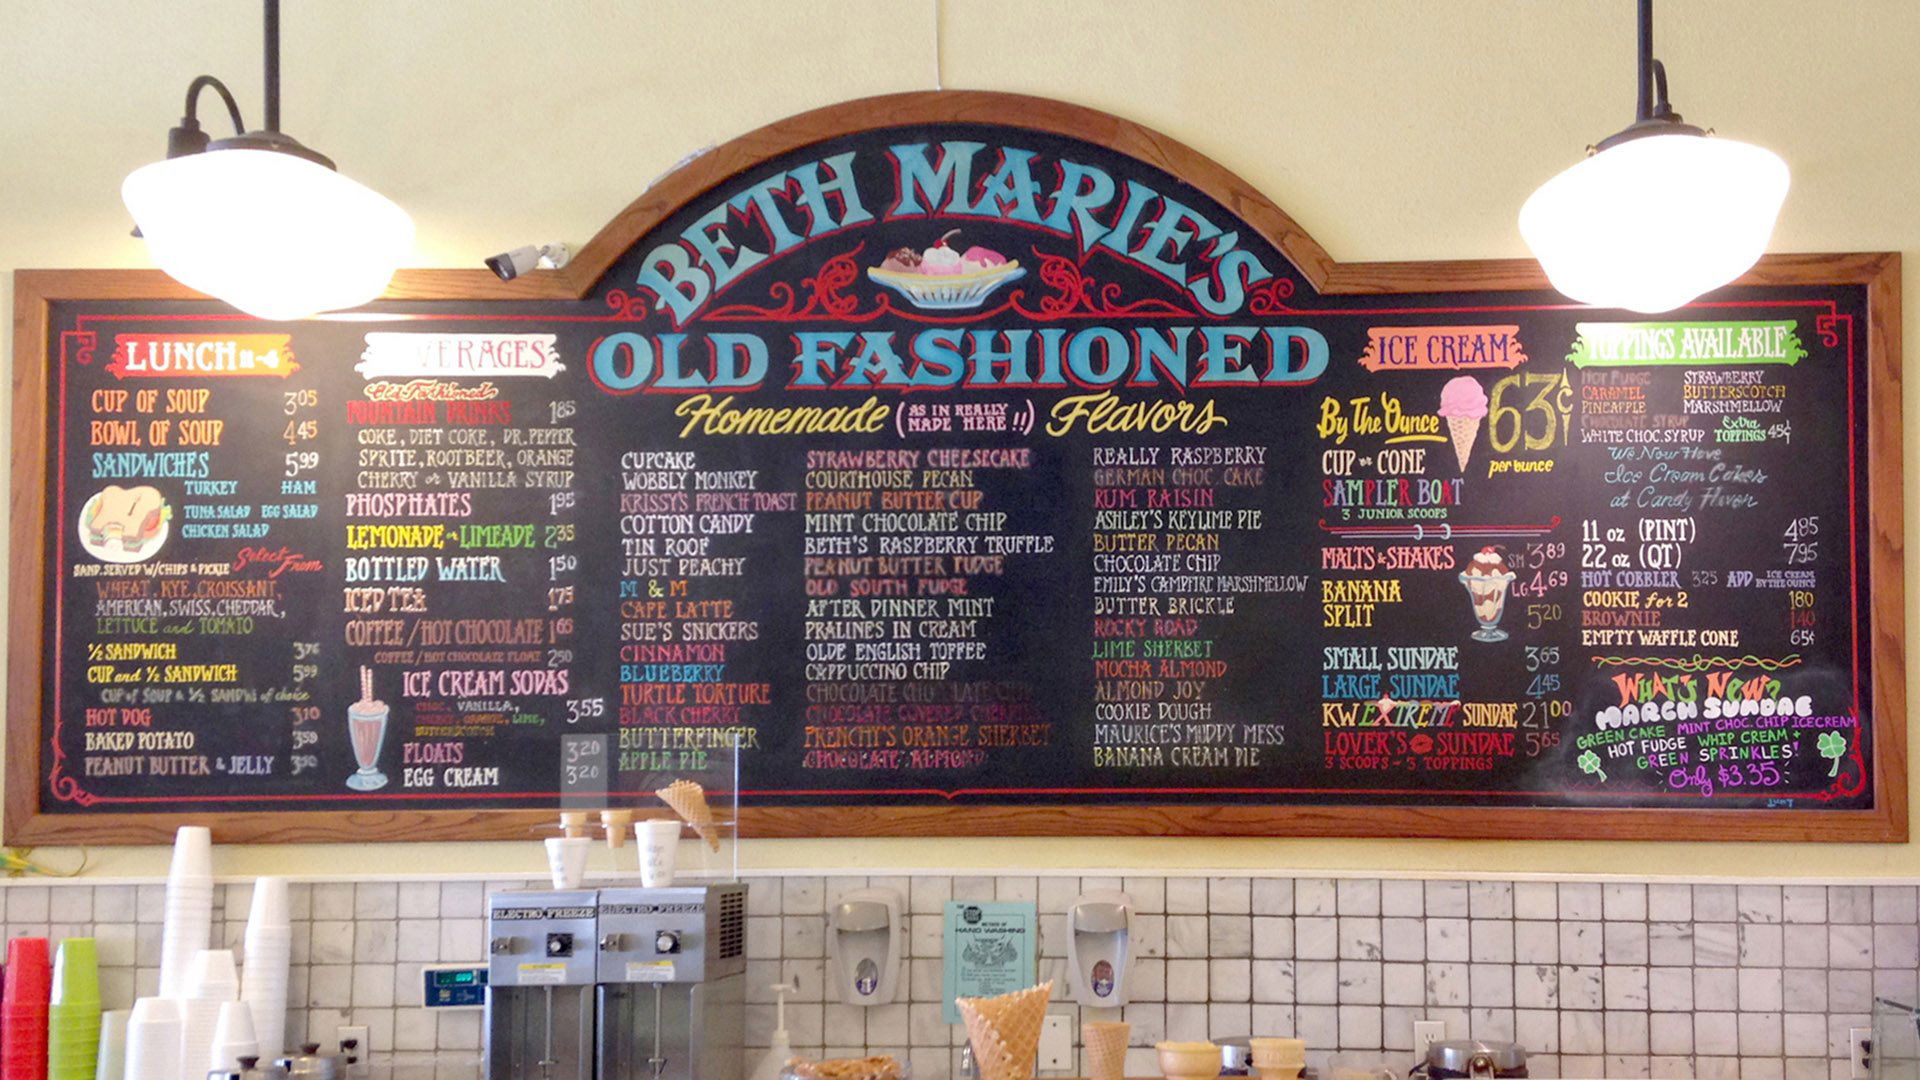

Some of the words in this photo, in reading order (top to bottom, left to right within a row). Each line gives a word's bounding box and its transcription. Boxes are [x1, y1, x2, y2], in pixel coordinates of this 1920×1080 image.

[636, 152, 876, 327] BETH
[884, 140, 1274, 318] MARIE'S
[1379, 335, 1417, 365] ICE
[1427, 333, 1509, 365] CREAM
[1586, 329, 1675, 360] TOPPINGS
[1680, 326, 1787, 359] AVAILABLE
[125, 342, 237, 370] LUNCH
[413, 339, 546, 370] VERAGES
[587, 330, 770, 396] OLD
[786, 325, 1332, 393] FASHIONED
[1684, 371, 1765, 384] STRAWBERRY
[92, 390, 128, 413] CUP
[136, 390, 158, 413] OF
[167, 389, 210, 413] SOUP
[955, 403, 1008, 416] REALLY
[1582, 401, 1646, 414] PINEAPPLE
[1683, 385, 1785, 399] BUTTERSCOTCH
[674, 394, 890, 438] Homemade
[908, 417, 952, 432] MADE
[963, 416, 1006, 432] HERE
[1045, 395, 1227, 438] Flavors
[1318, 397, 1348, 444] By
[1382, 392, 1439, 434] Ounce
[91, 421, 141, 446] BOWL
[150, 421, 170, 446] OF
[179, 420, 223, 445] SOUP
[410, 429, 443, 445] DIET
[1715, 430, 1766, 442] TOPPINGS
[92, 452, 209, 478] SANDWICHES
[517, 450, 574, 467] ORANGE
[622, 452, 695, 470] CUPCAKE
[807, 450, 921, 469] STRAWBERRY
[927, 449, 1030, 468] CHEESECAKE
[1171, 446, 1267, 466] RASPBERRY
[1323, 450, 1355, 475] CUP
[1377, 449, 1426, 474] CONE
[448, 472, 517, 488] VANILLA
[525, 471, 574, 488] SYRUP
[622, 472, 687, 490] WOBBLY
[695, 471, 758, 490] MONKEY
[806, 471, 913, 489] COURTHOUSE
[923, 470, 973, 488] PECAN
[1650, 463, 1705, 483] Cream
[184, 481, 238, 495] TURKEY
[281, 481, 316, 494] HAM
[1323, 479, 1411, 506] SAMPLER
[1417, 479, 1464, 505] BOAT
[345, 494, 471, 517] PHOSPHATES
[620, 492, 688, 513] KRISSY'S
[806, 492, 872, 511] PEANUT
[882, 492, 946, 510] BUTTER
[950, 492, 984, 509] CUP
[1637, 486, 1691, 512] Candy
[182, 525, 229, 538] CHICKEN
[621, 514, 693, 535] COTTON
[700, 514, 754, 534] CANDY
[805, 514, 854, 533] MINT
[862, 513, 958, 532] CHOCOLATE
[966, 512, 1007, 532] CHIP
[1607, 529, 1625, 542] oz
[1639, 518, 1696, 544] (PINT)
[346, 525, 444, 549] LEMONADE
[460, 524, 535, 549] LIMEADE
[804, 536, 868, 555] BETH'S
[880, 537, 979, 555] RASPBERRY
[985, 536, 1054, 555] TRUFFLE
[1094, 534, 1159, 551] BUTTER
[1167, 534, 1220, 551] PECAN
[622, 538, 655, 556] TIN
[665, 537, 709, 557] ROOF
[1582, 545, 1606, 568] 22
[1612, 554, 1630, 567] oz
[1639, 544, 1681, 570] (QT)
[269, 554, 322, 578] From
[622, 559, 671, 576] JUST
[679, 558, 745, 576] PEACHY
[1094, 555, 1181, 573] CHOCOLATE
[1322, 547, 1375, 570] MALTS
[1387, 546, 1455, 570] SHAKES
[345, 557, 428, 582] BOTTLED
[435, 556, 506, 583] WATER
[1616, 571, 1681, 588] COBBLER
[1322, 580, 1402, 603] BANANA
[1583, 591, 1640, 608] COOKIE
[948, 598, 994, 617] MINT
[1324, 604, 1375, 627] SPLIT
[97, 618, 157, 634] LETTUCE
[200, 618, 253, 634] TOMATO
[1582, 611, 1661, 627] BROWNIE
[683, 622, 759, 641] SNICKERS
[1582, 631, 1635, 646] EMPTY
[1637, 631, 1696, 646] WAFFLE
[1701, 631, 1739, 647] CONE
[106, 644, 176, 660] SANDWICH
[620, 644, 725, 662] CINNAMON
[855, 644, 921, 661] ENGLISH
[1092, 641, 1134, 659] LIME
[1144, 640, 1213, 659] SHERBET
[1323, 647, 1382, 671] SMALL
[1387, 646, 1459, 670] SUNDAE
[87, 666, 114, 682] CUP
[165, 665, 237, 682] SANDWICH
[620, 664, 725, 683] BLUEBERRY
[806, 663, 907, 681] CAPPUCCINO
[1095, 661, 1151, 678] MOCHA
[402, 671, 431, 697] ICE
[439, 671, 504, 698] CREAM
[510, 670, 568, 696] SODAS
[1322, 675, 1381, 699] LARGE
[1390, 674, 1460, 698] SUNDAE
[620, 684, 686, 705] TURTLE
[692, 684, 771, 704] TORTURE
[86, 709, 116, 727] HOT
[122, 709, 151, 726] DOG
[1463, 703, 1518, 727] SUNDAE
[1596, 701, 1698, 730] MARCH
[85, 732, 131, 751] BAKED
[137, 732, 194, 749] POTATO
[619, 727, 759, 749] BUTTERFINGER
[1094, 725, 1181, 745] MAURICE'S
[1187, 724, 1236, 744] MUDDY
[1244, 724, 1284, 745] MESS
[1629, 726, 1665, 739] CAKE
[1698, 733, 1734, 747] WHIP
[1741, 731, 1788, 743] CREAM
[403, 743, 464, 763] FLOATS
[1608, 741, 1634, 759] HOT
[1642, 737, 1686, 753] FUDGE
[85, 757, 144, 776] PEANUT
[151, 757, 210, 775] BUTTER
[228, 756, 274, 774] JELLY
[1424, 757, 1493, 770] TOPPINGS
[404, 768, 434, 787] EGG
[444, 767, 499, 786] CREAM
[1669, 766, 1713, 797] Only
[1719, 761, 1780, 787] $3.35
